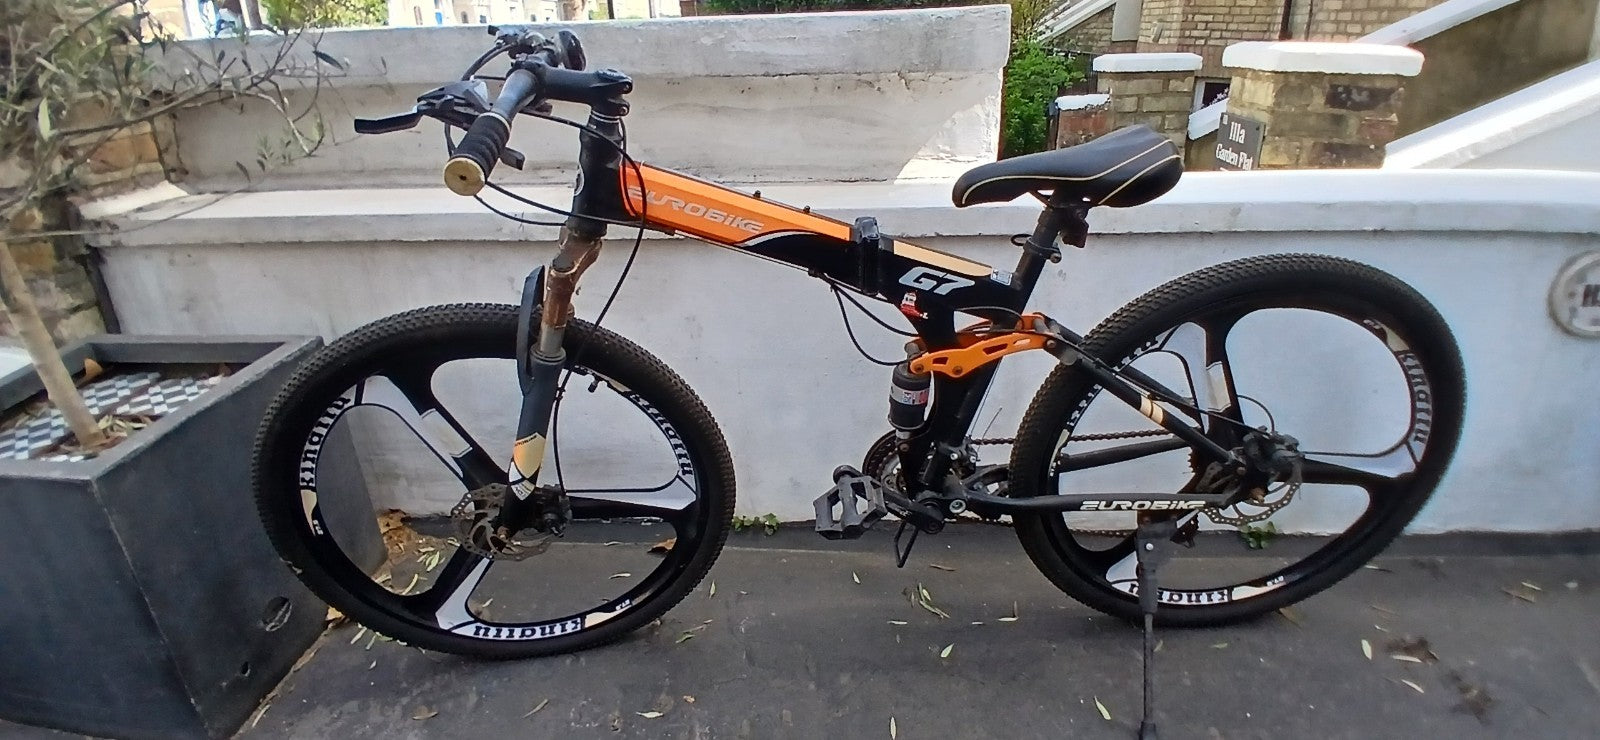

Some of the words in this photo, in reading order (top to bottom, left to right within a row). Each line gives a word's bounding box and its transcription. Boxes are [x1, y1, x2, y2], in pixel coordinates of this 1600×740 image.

[1216, 143, 1239, 166] Garden
[1238, 151, 1254, 171] Flat
[898, 266, 976, 295] G7
